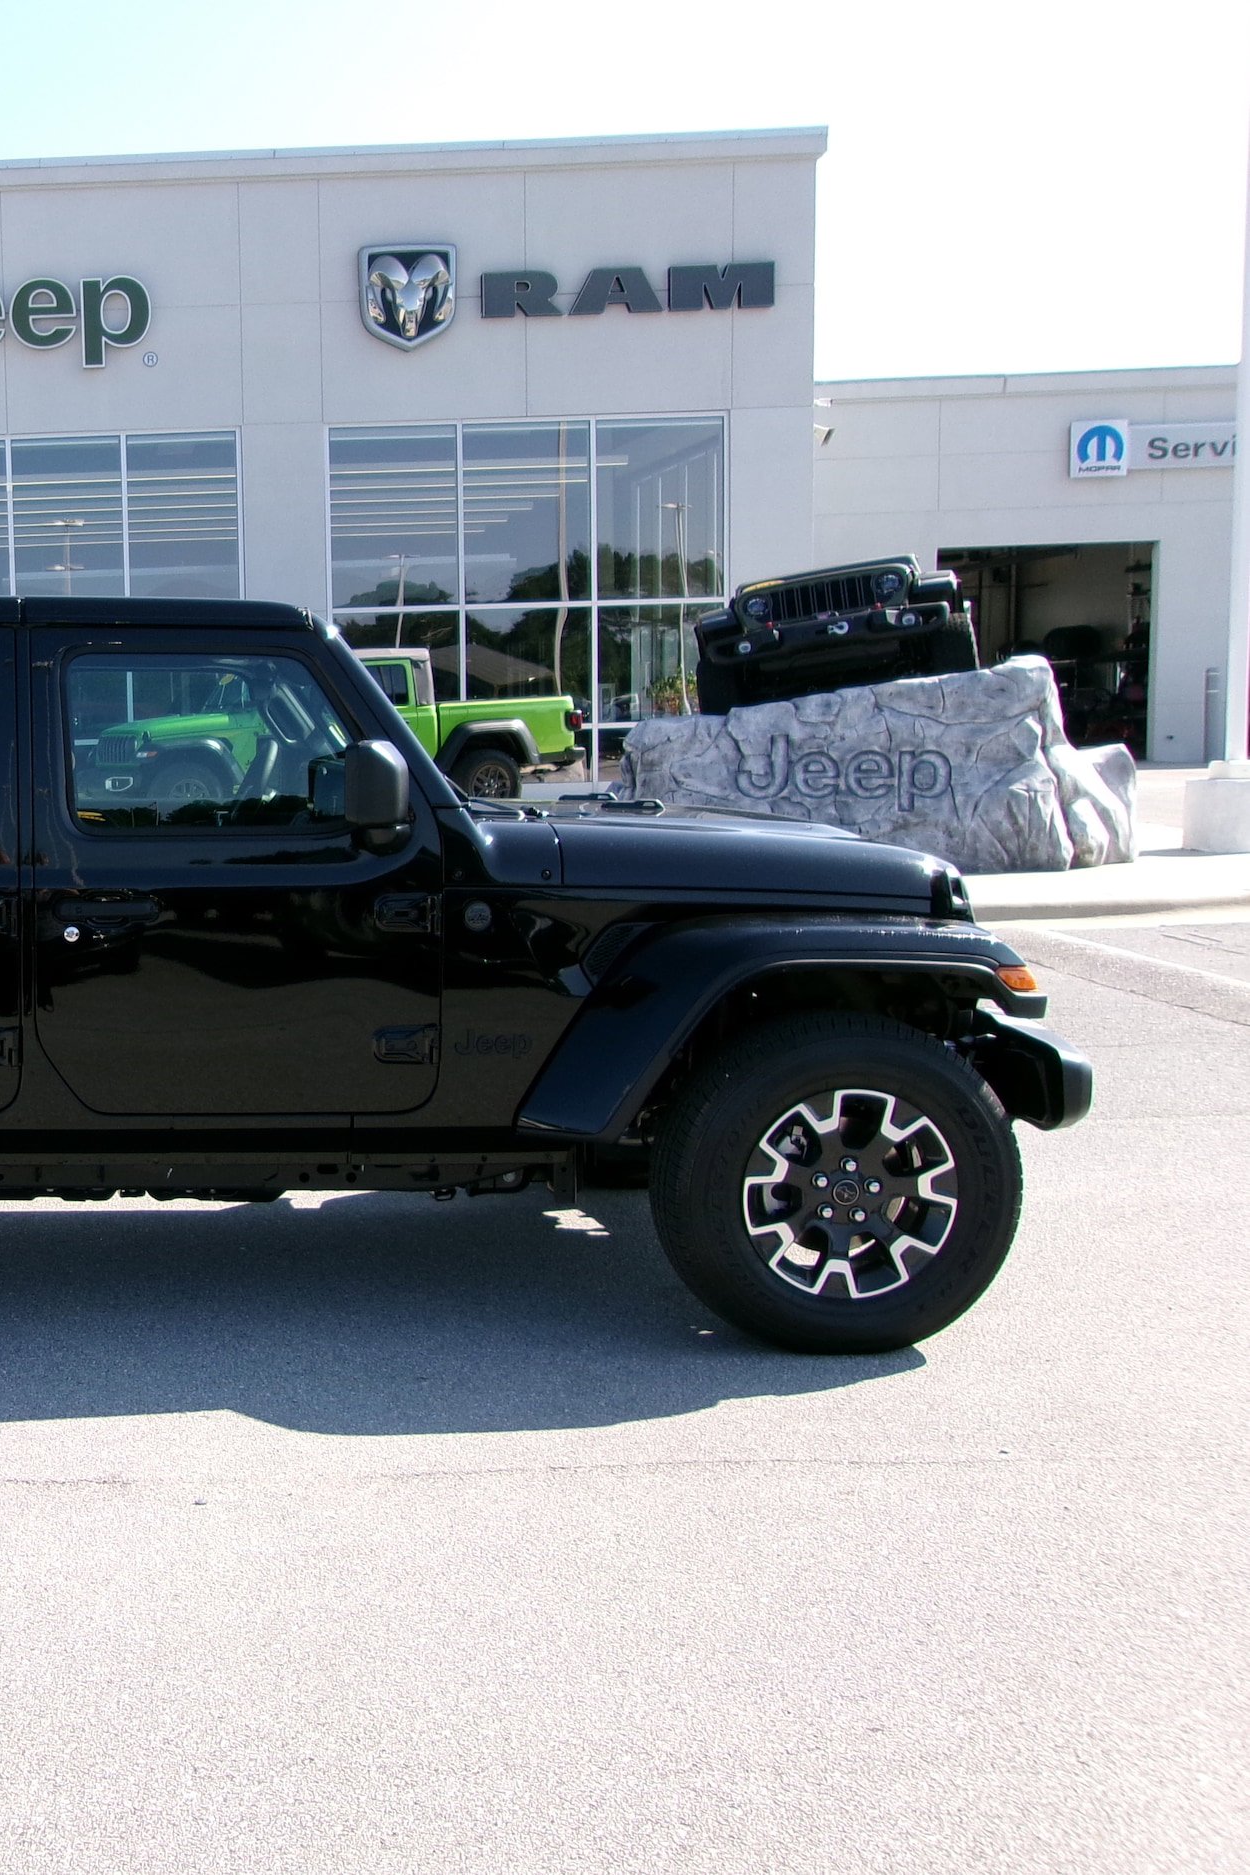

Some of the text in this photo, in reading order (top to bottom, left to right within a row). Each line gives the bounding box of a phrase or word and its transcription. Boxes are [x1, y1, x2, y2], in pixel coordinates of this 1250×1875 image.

[481, 261, 775, 319] RAM
[1078, 465, 1122, 474] MOPAR
[735, 734, 951, 812] Jeep
[454, 1029, 532, 1060] Jeep
